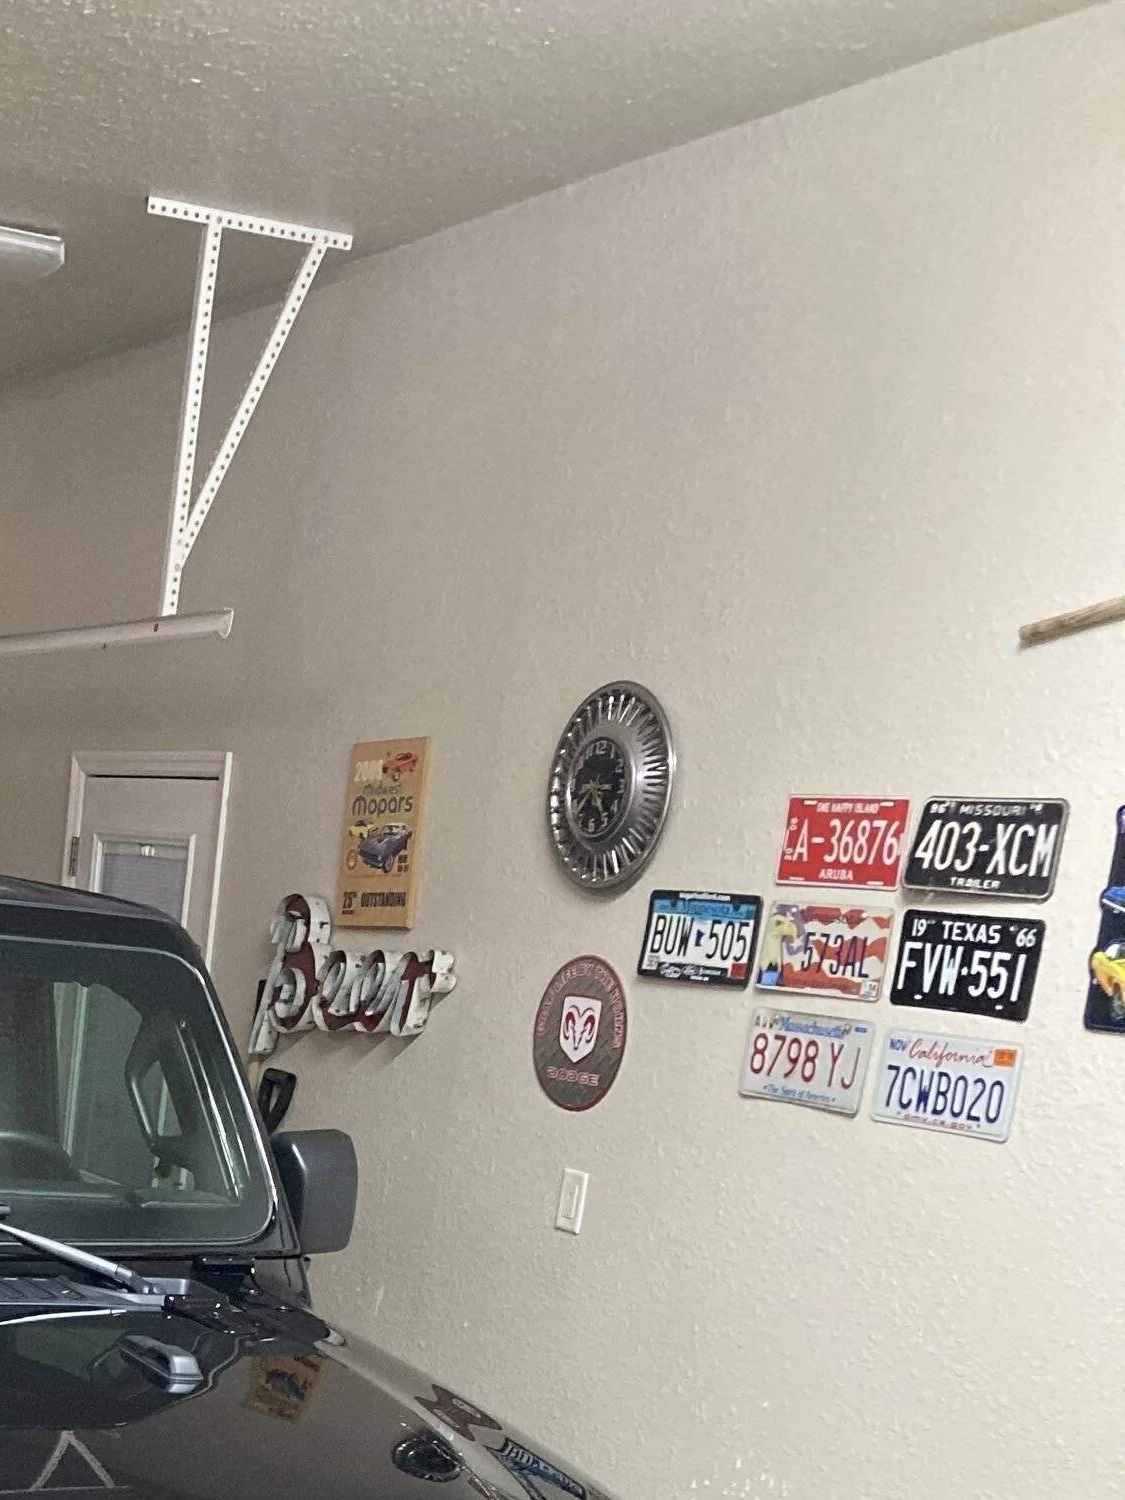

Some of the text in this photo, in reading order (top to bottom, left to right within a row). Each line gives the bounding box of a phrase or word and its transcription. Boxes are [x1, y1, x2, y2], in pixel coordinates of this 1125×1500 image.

[352, 794, 413, 818] Mopars
[958, 804, 1026, 816] MISSOURI
[792, 818, 900, 866] A-36876
[914, 819, 1059, 877] 403-XCM
[818, 868, 854, 881] ARUBA
[950, 876, 1002, 890] TRAILER
[650, 914, 750, 962] BUW 505
[911, 918, 1037, 947] 19 TEXAS 66
[801, 931, 869, 979] 573AL
[750, 1032, 861, 1089] 8798 YJ
[909, 1038, 987, 1068] California
[546, 1066, 600, 1087] DODGE
[885, 1064, 1005, 1124] 7CWB020
